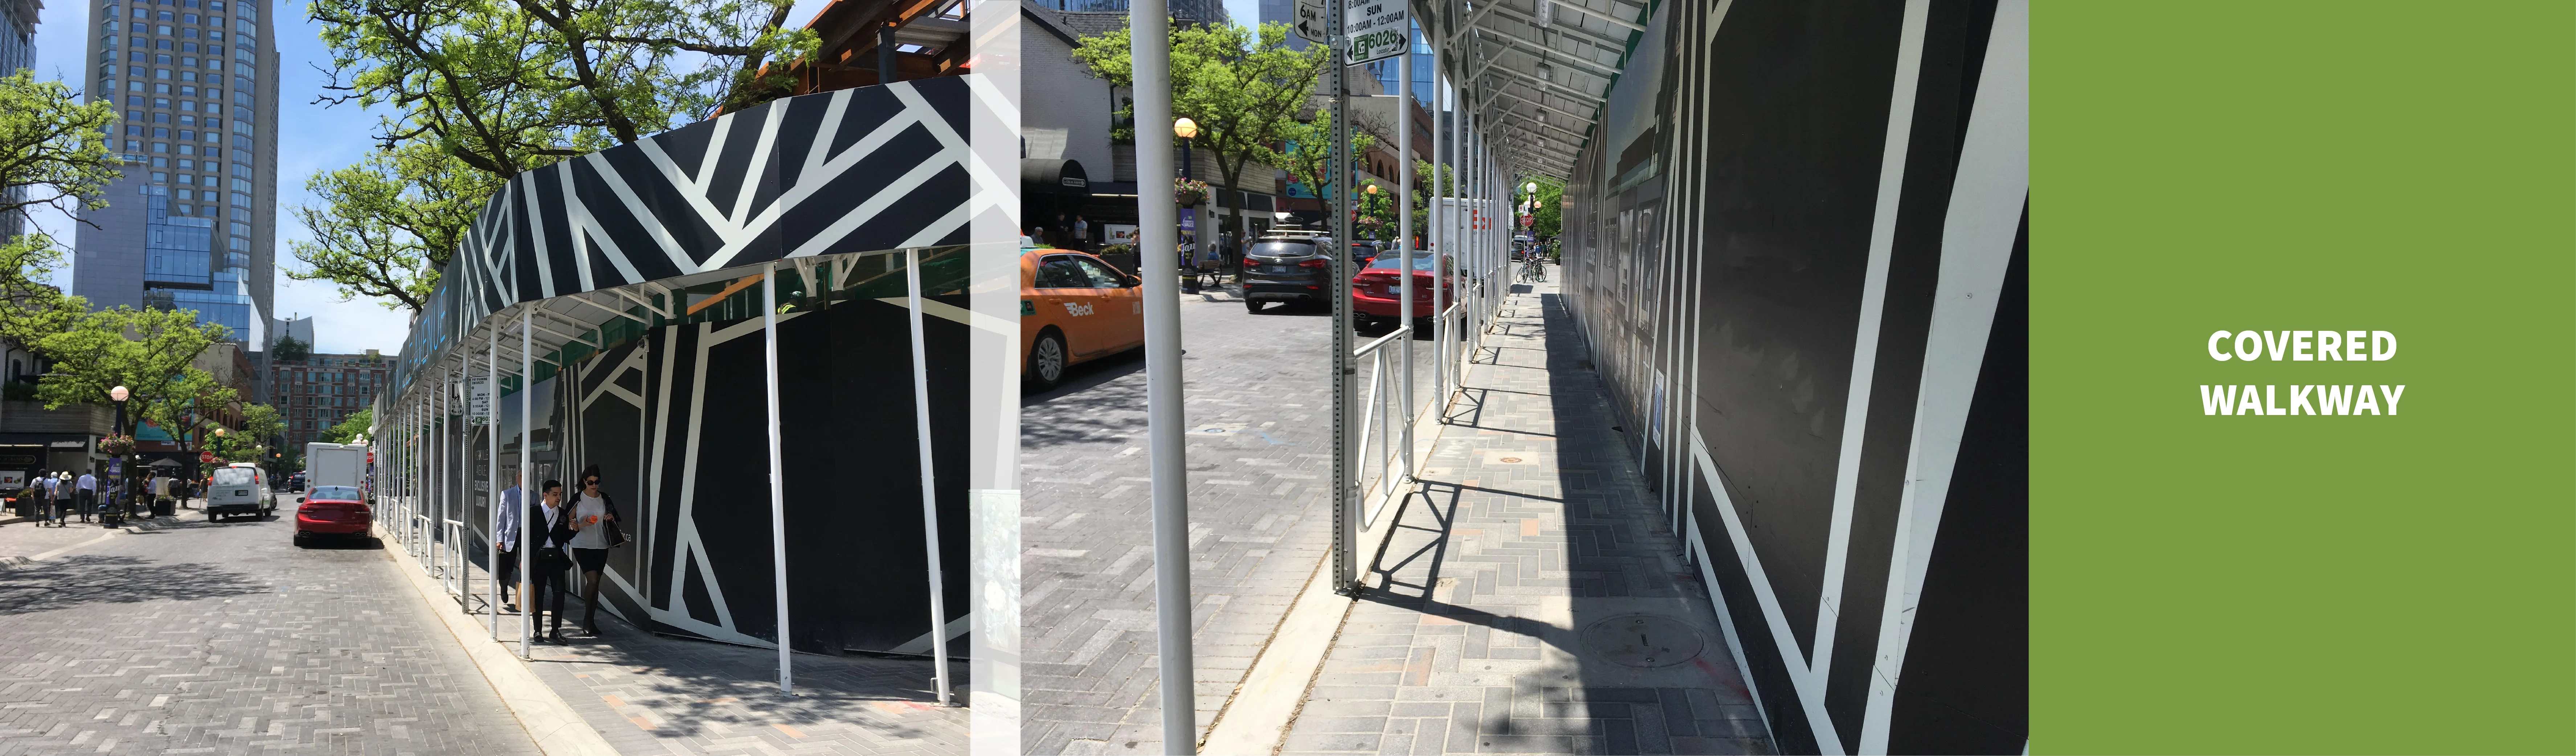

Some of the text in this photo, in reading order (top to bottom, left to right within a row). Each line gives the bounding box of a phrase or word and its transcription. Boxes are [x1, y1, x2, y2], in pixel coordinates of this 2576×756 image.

[1300, 4, 1316, 22] 6AM
[1367, 3, 1382, 16] SUN
[1347, 19, 1371, 34] 10:00AM
[1377, 10, 1404, 26] 12:00AM
[1311, 28, 1321, 37] MON
[1369, 30, 1397, 49] 6026
[1064, 302, 1094, 316] Beck
[414, 286, 446, 371] AVENUE
[474, 480, 488, 493] EXCLUSIVE
[476, 495, 486, 508] LUXURY
